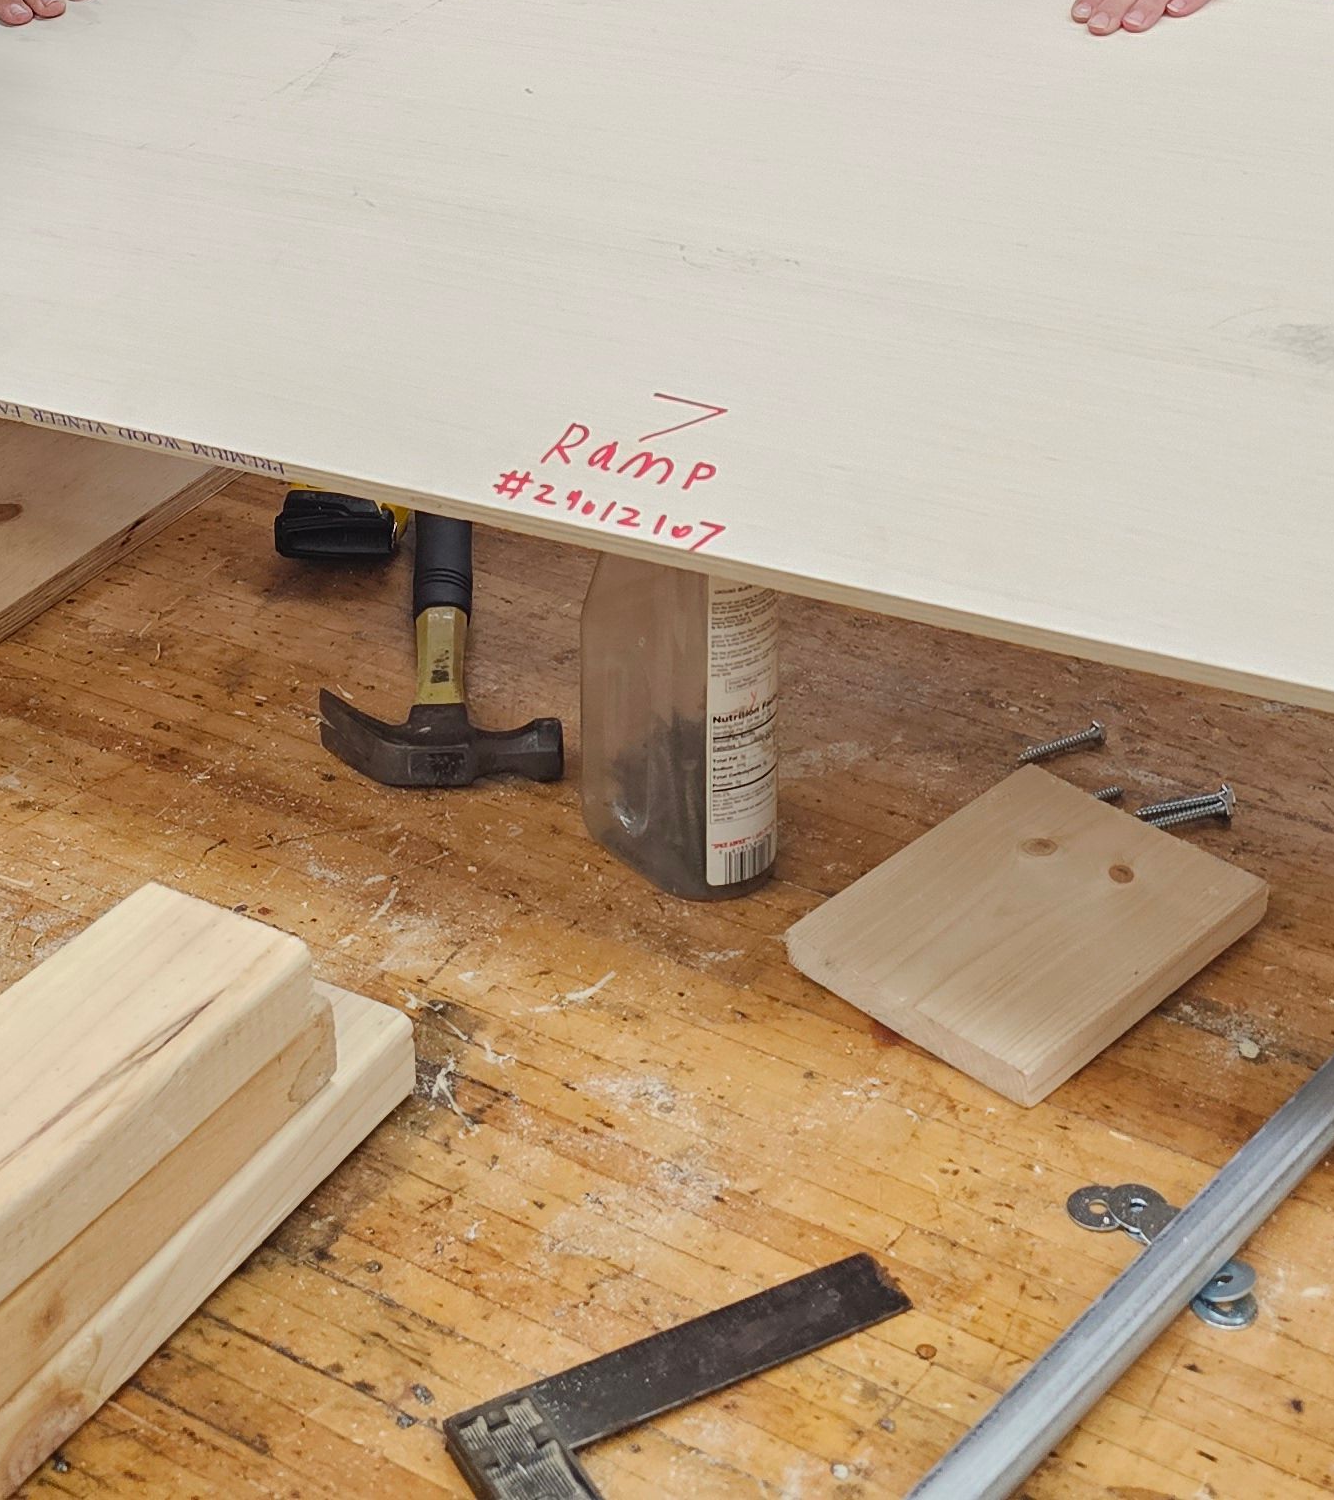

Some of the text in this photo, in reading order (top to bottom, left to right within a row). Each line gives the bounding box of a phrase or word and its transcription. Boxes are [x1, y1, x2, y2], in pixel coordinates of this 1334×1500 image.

[32, 407, 108, 436] VENEER
[117, 427, 182, 451] WOOD
[190, 441, 286, 476] PREMIUM
[540, 422, 717, 491] Ramp
